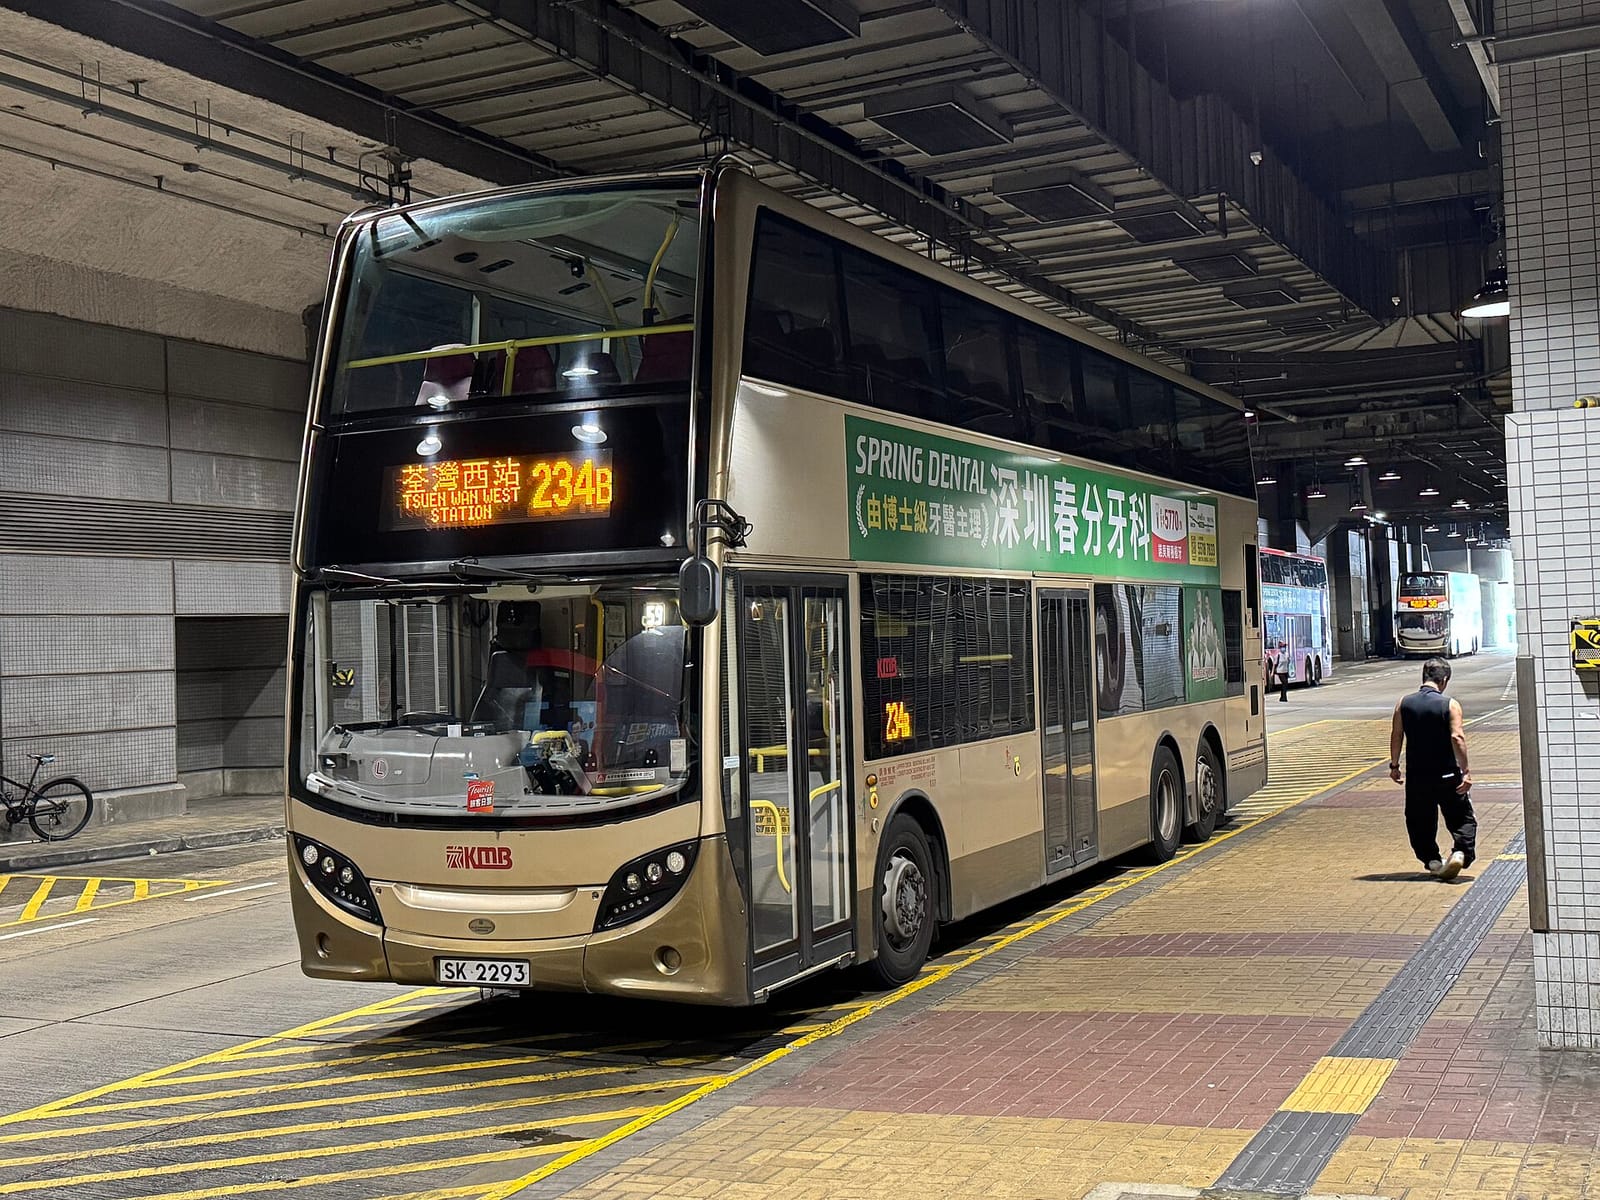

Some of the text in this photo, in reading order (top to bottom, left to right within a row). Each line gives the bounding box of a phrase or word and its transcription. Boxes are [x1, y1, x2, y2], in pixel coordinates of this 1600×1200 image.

[402, 457, 521, 494] 荃灣西站
[531, 458, 613, 509] 234B
[855, 435, 988, 495] SPRING DENTAL
[402, 486, 521, 509] TSUEN WAN WEST
[430, 504, 493, 523] STATION
[867, 492, 983, 539] 由博士級牙醫主理
[990, 463, 1150, 562] 深圳春分牙科
[463, 846, 513, 870] KMB
[444, 962, 526, 983] SK 2293
